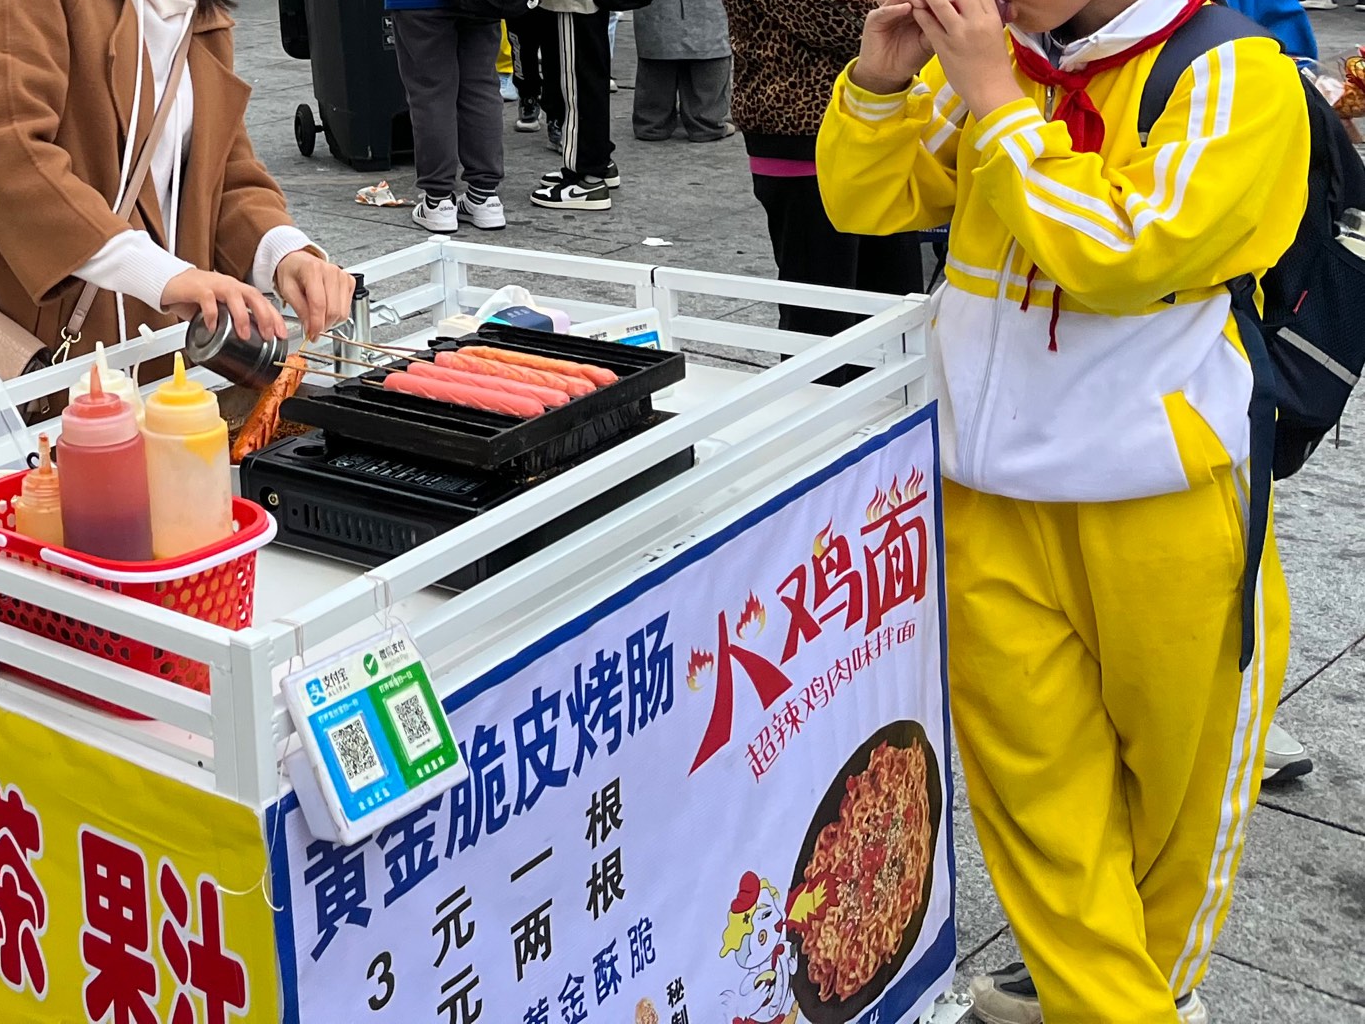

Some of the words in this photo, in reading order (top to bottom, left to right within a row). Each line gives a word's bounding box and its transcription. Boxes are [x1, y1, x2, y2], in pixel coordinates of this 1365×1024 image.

[322, 667, 348, 691] 支付宝
[328, 681, 351, 698] ALIPAY
[688, 476, 928, 776] 火鸡面
[744, 617, 916, 783] 超辣鸡肉味拌面
[303, 610, 675, 962] 黄金脆皮烤肠
[78, 822, 251, 1024] 果汁
